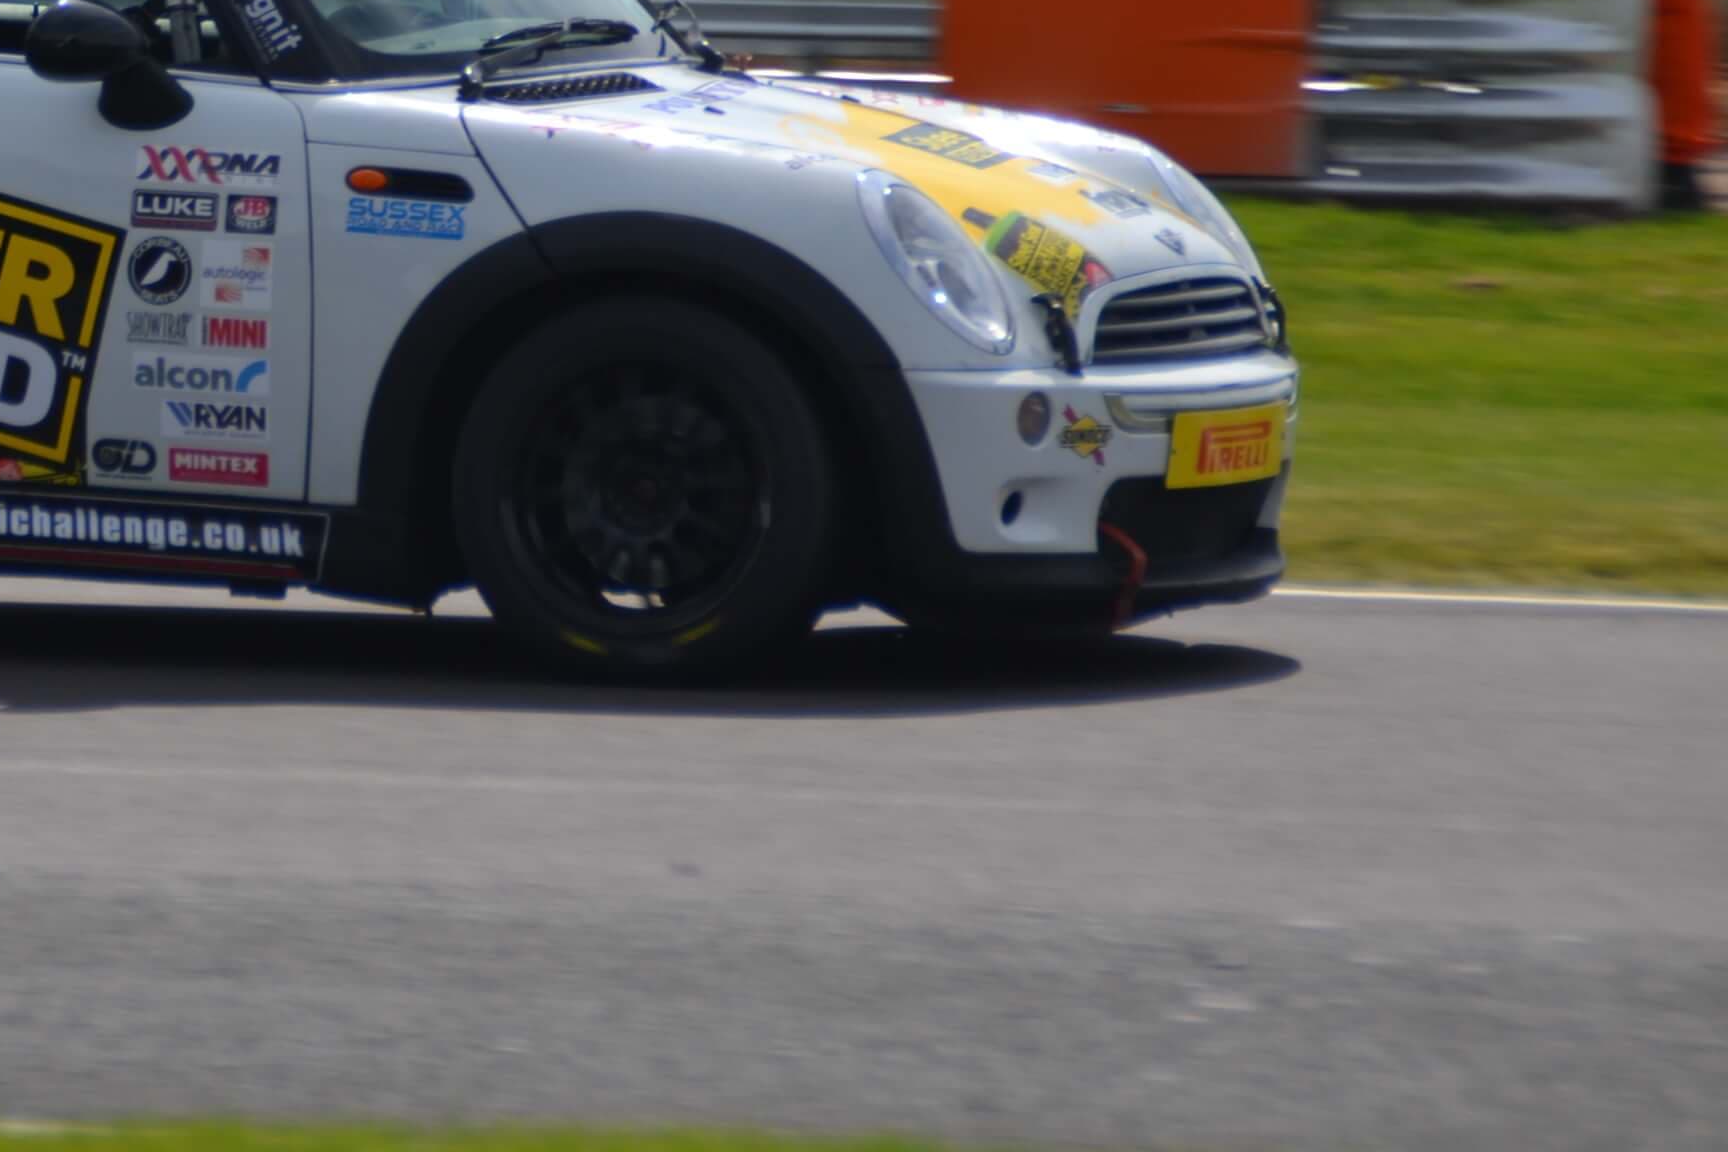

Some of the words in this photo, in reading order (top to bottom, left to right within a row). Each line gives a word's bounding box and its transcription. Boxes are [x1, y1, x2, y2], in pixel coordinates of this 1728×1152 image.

[136, 195, 213, 216] LUKE
[348, 196, 465, 224] SUSSEX
[202, 266, 265, 284] autologic
[209, 317, 267, 349] MINI
[134, 357, 233, 391] alcon
[194, 403, 266, 433] RYAN
[1197, 420, 1271, 475] PIRELLI
[174, 452, 257, 474] MINTEX
